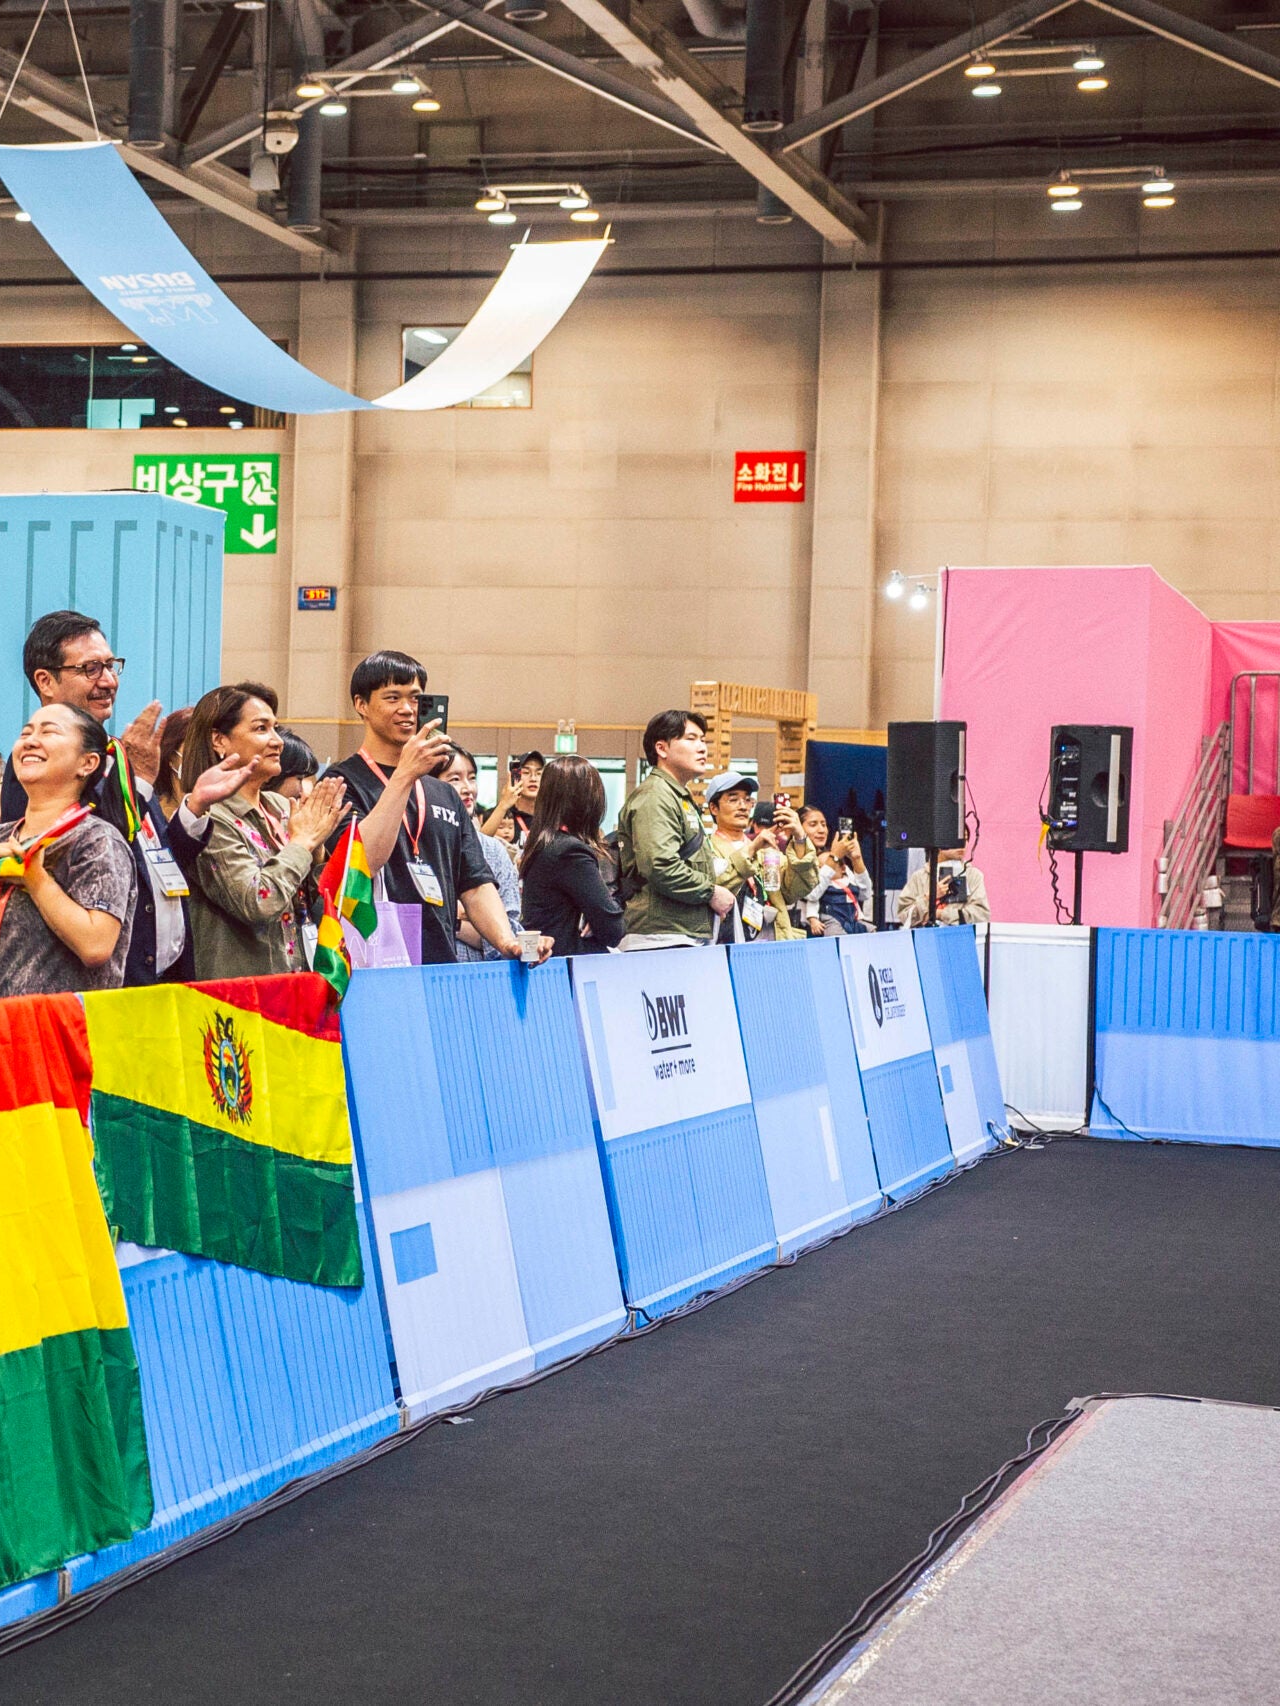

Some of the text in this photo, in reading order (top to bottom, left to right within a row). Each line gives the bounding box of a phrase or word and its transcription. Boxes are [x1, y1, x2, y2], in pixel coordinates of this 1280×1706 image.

[99, 271, 197, 291] BUSAN
[135, 462, 239, 503] 비상구
[737, 461, 787, 482] 소화전
[737, 482, 753, 491] Fire
[431, 804, 459, 827] FIX.
[656, 994, 688, 1038] BWT
